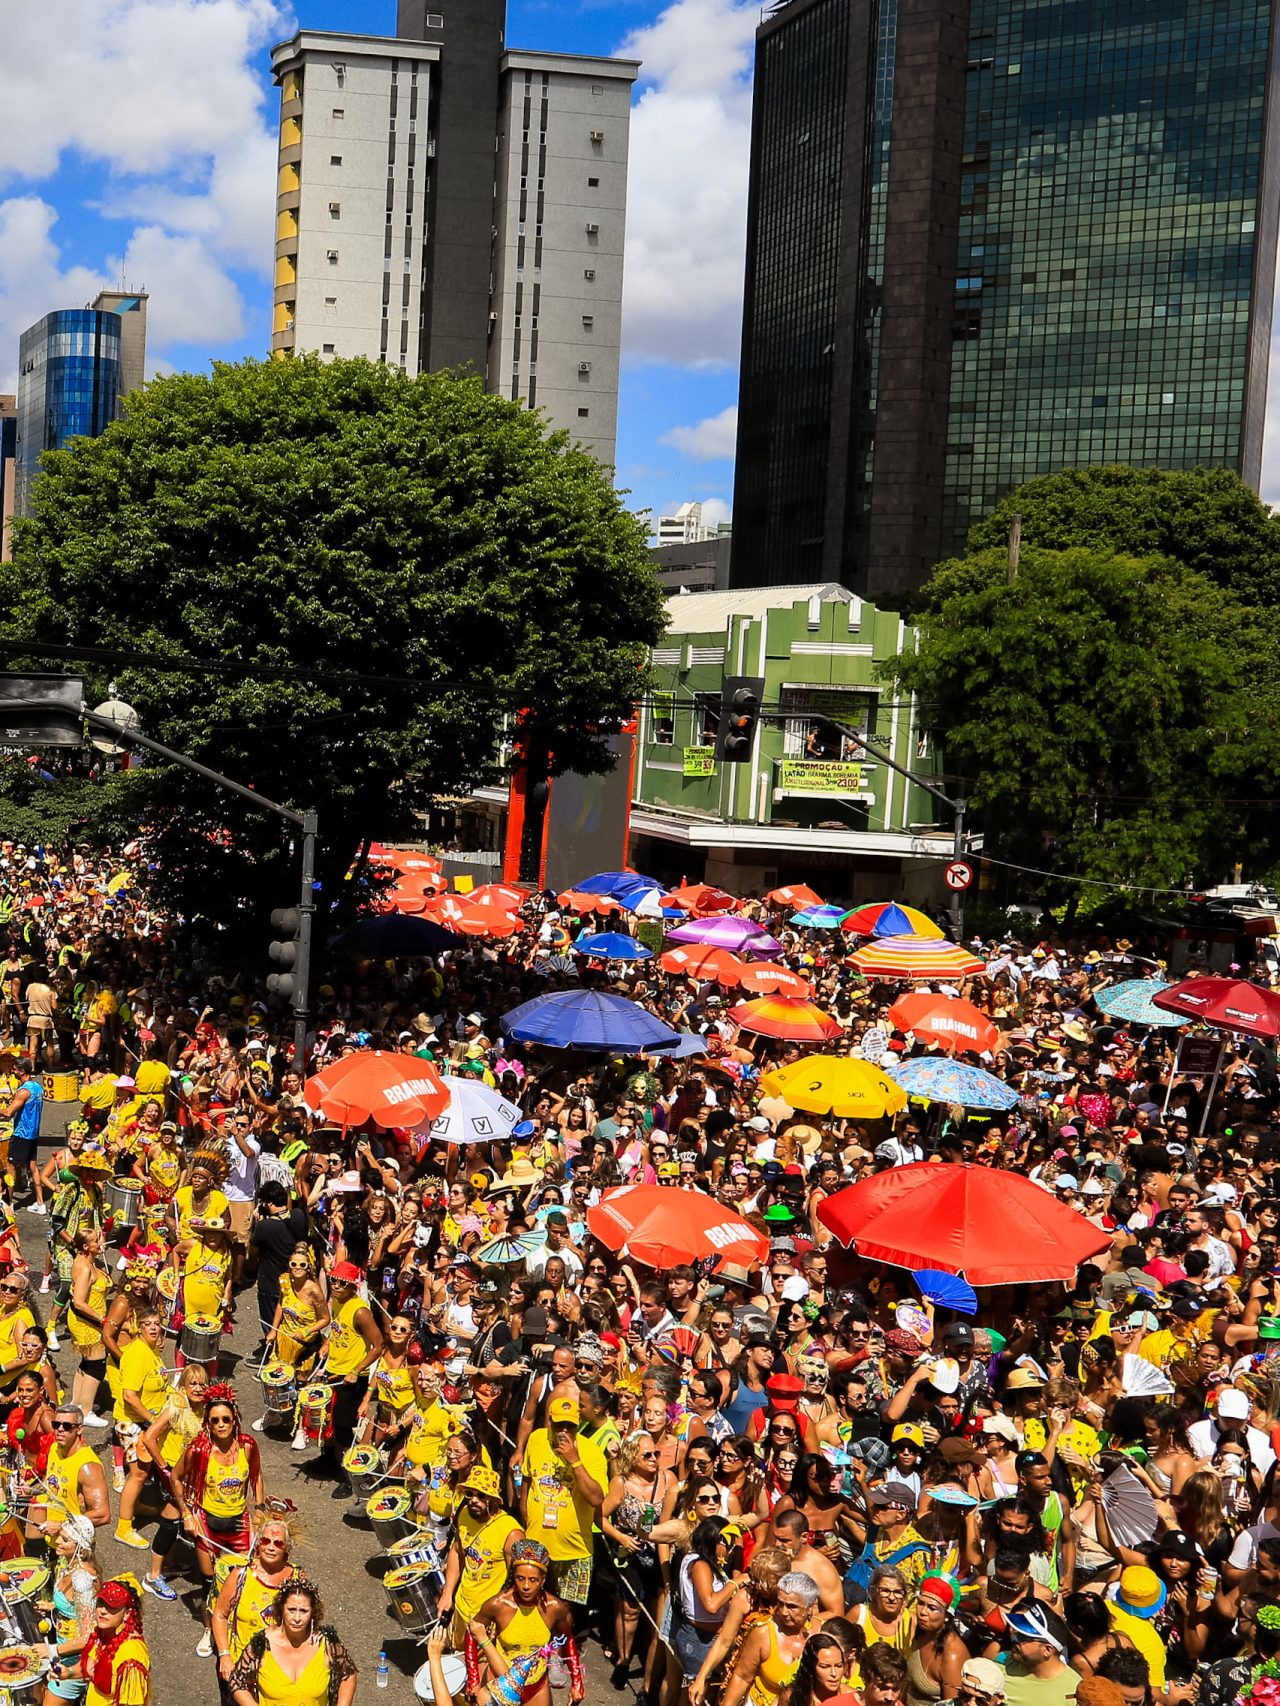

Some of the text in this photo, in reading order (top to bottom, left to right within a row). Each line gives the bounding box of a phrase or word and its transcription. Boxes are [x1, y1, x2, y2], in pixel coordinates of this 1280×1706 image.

[755, 970, 798, 986] BRAHMA
[930, 1017, 978, 1041] BRAHMA
[382, 1077, 438, 1106] BRAHMA
